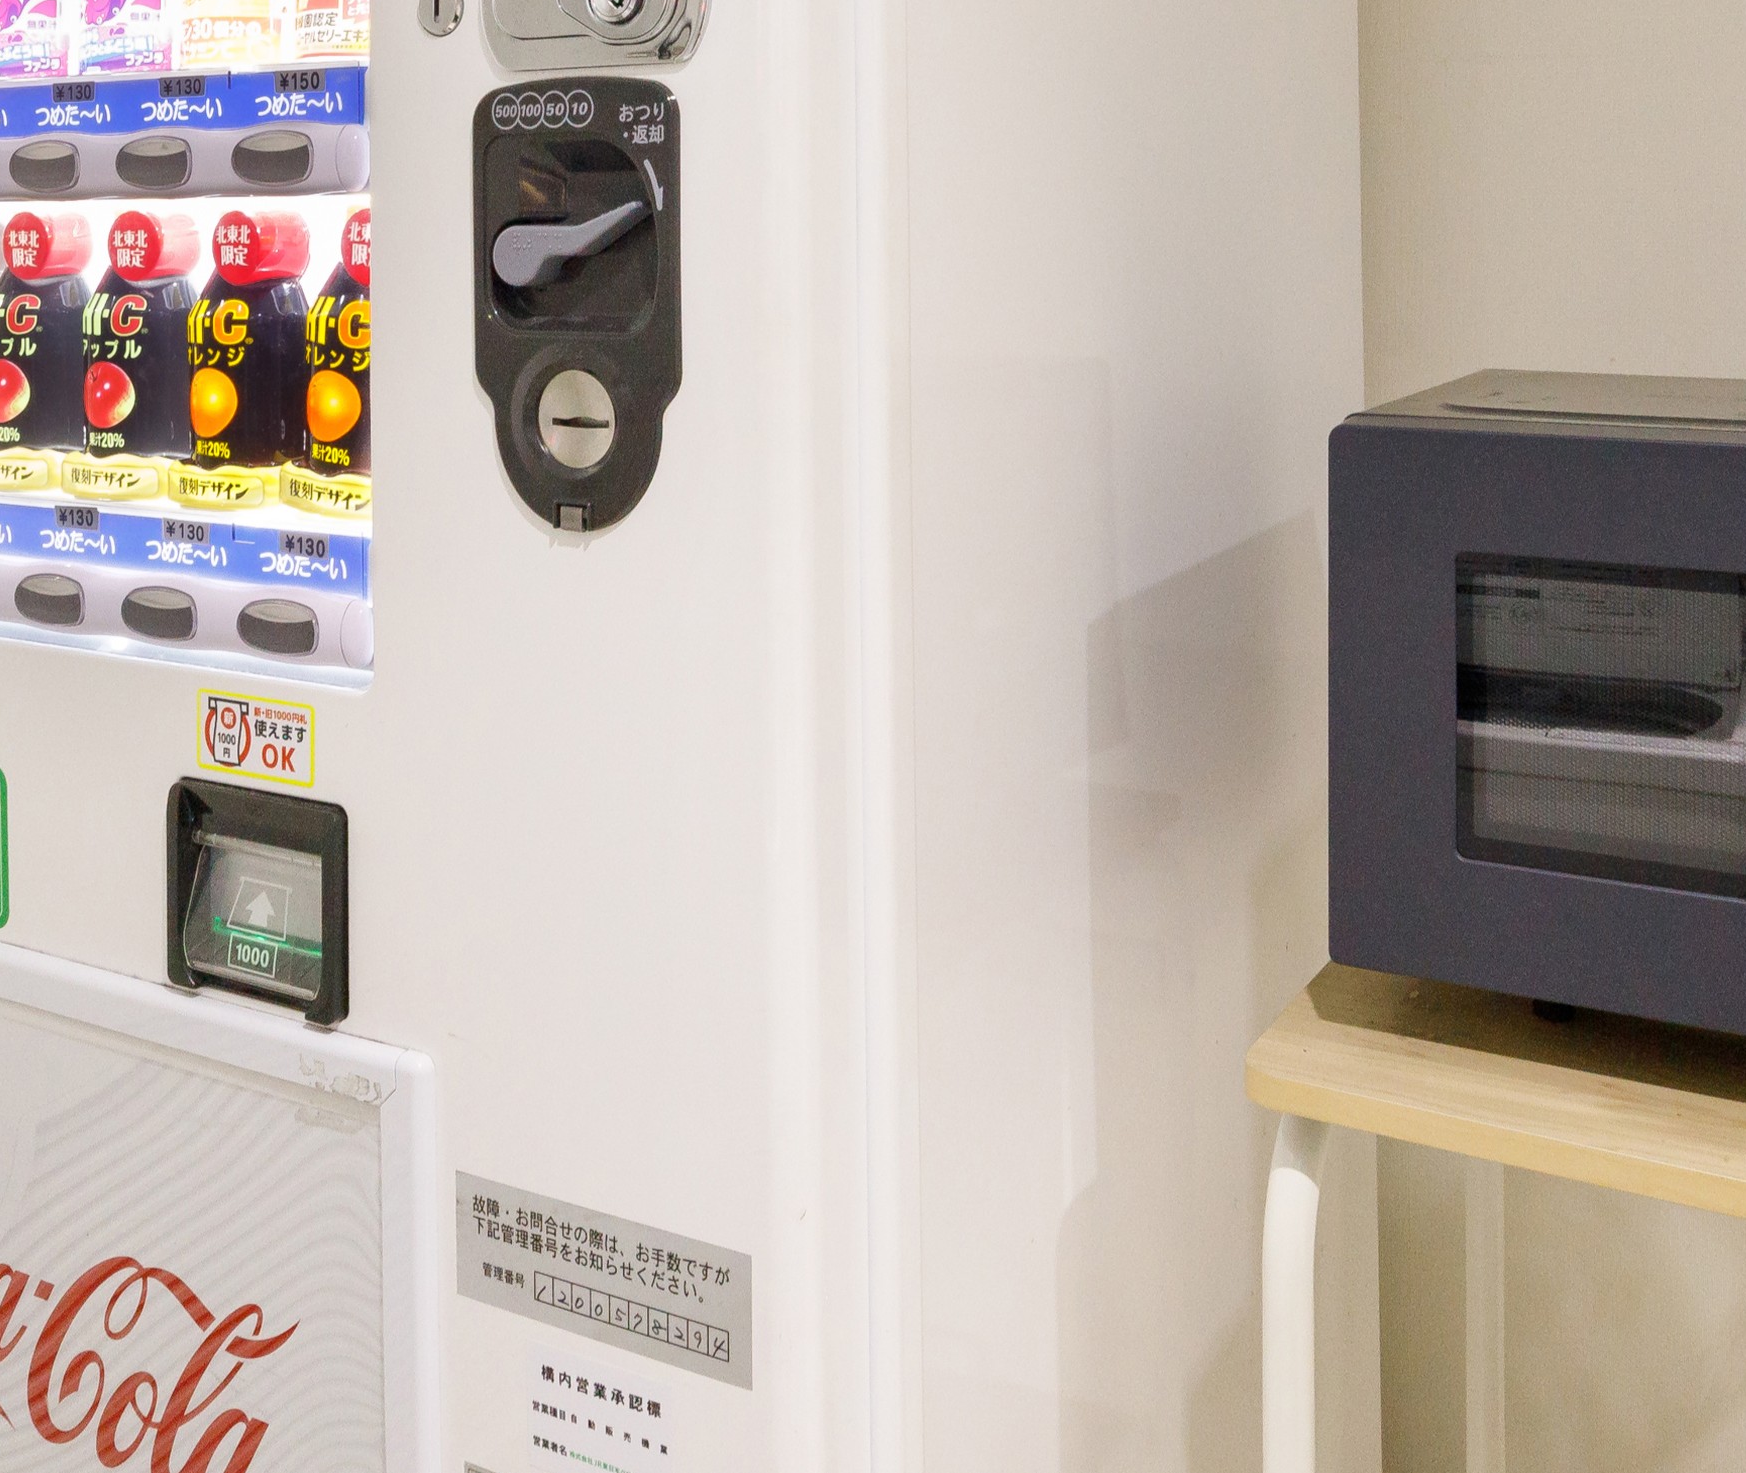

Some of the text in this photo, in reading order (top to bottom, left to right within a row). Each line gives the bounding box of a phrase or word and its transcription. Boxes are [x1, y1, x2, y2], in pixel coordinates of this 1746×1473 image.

[163, 79, 202, 95] ¥130
[279, 72, 320, 90] ¥150
[56, 84, 92, 100] ¥130
[495, 101, 589, 119] 500 100 50 10
[618, 102, 665, 122] おつり
[8, 229, 40, 248] 北東北
[112, 229, 148, 248] 北東北
[216, 224, 251, 245] 北東北
[12, 248, 38, 268] 限定
[116, 248, 146, 269] 限定
[220, 245, 249, 267] 限定
[89, 432, 125, 448] 果汁20%
[196, 440, 231, 459] 果汁20%
[311, 443, 350, 466] 果汁20%
[71, 467, 141, 488] 復刻デザイン
[179, 477, 249, 500] 復刻デザイン
[289, 478, 371, 511] 復刻デザイン
[59, 509, 94, 528] ¥130
[166, 520, 205, 542] ¥130
[284, 534, 326, 558] ¥130
[253, 706, 308, 726] 新・旧1000円札
[217, 732, 236, 746] 1000
[254, 719, 307, 743] 使えます
[223, 747, 231, 758] 円
[261, 743, 296, 773] OK
[235, 943, 270, 968] 1000
[472, 1214, 705, 1304] 下記管理番号をお知らせください。
[482, 1262, 525, 1289] 管理番号
